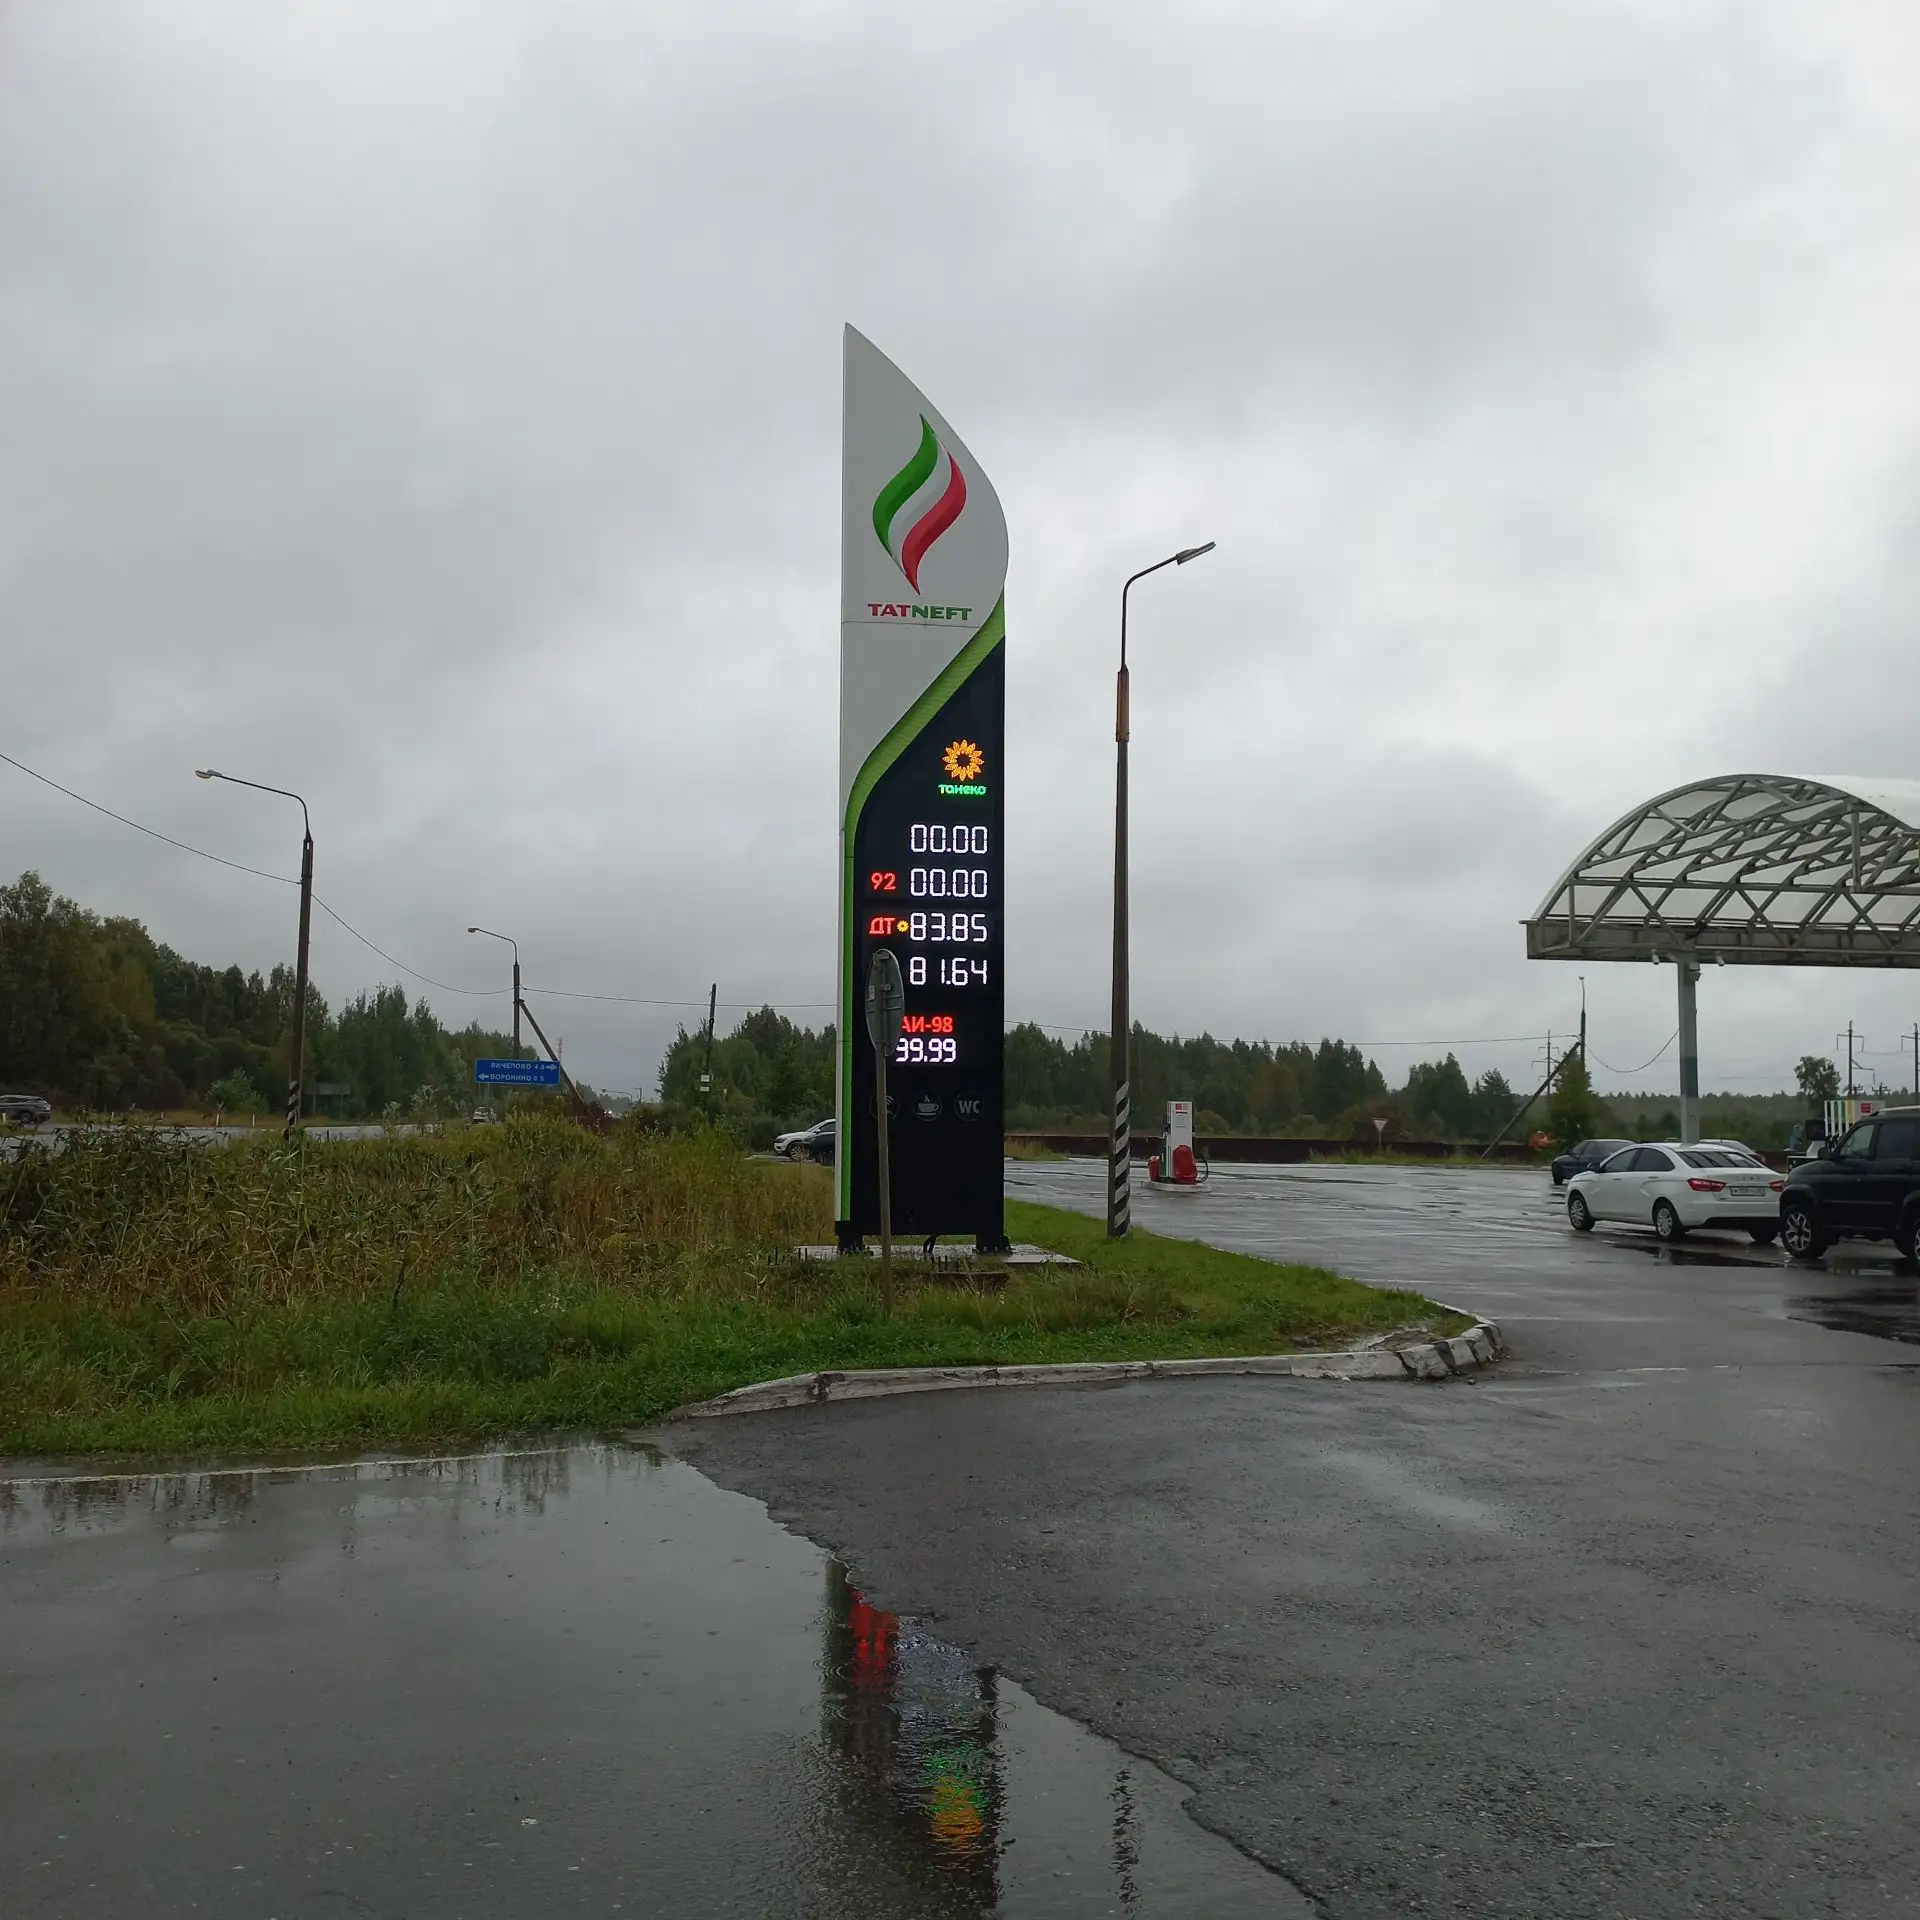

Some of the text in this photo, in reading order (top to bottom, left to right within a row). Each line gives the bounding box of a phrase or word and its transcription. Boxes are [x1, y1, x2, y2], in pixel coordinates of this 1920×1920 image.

[867, 603, 973, 621] TATNEFT
[910, 824, 988, 854] 00.00
[871, 868, 988, 898] 92 00.00
[868, 912, 988, 942] ДТ 83.85
[901, 1017, 954, 1033] АИ-98
[489, 1073, 532, 1082] ВОРОНИНО
[958, 1099, 980, 1114] WC
